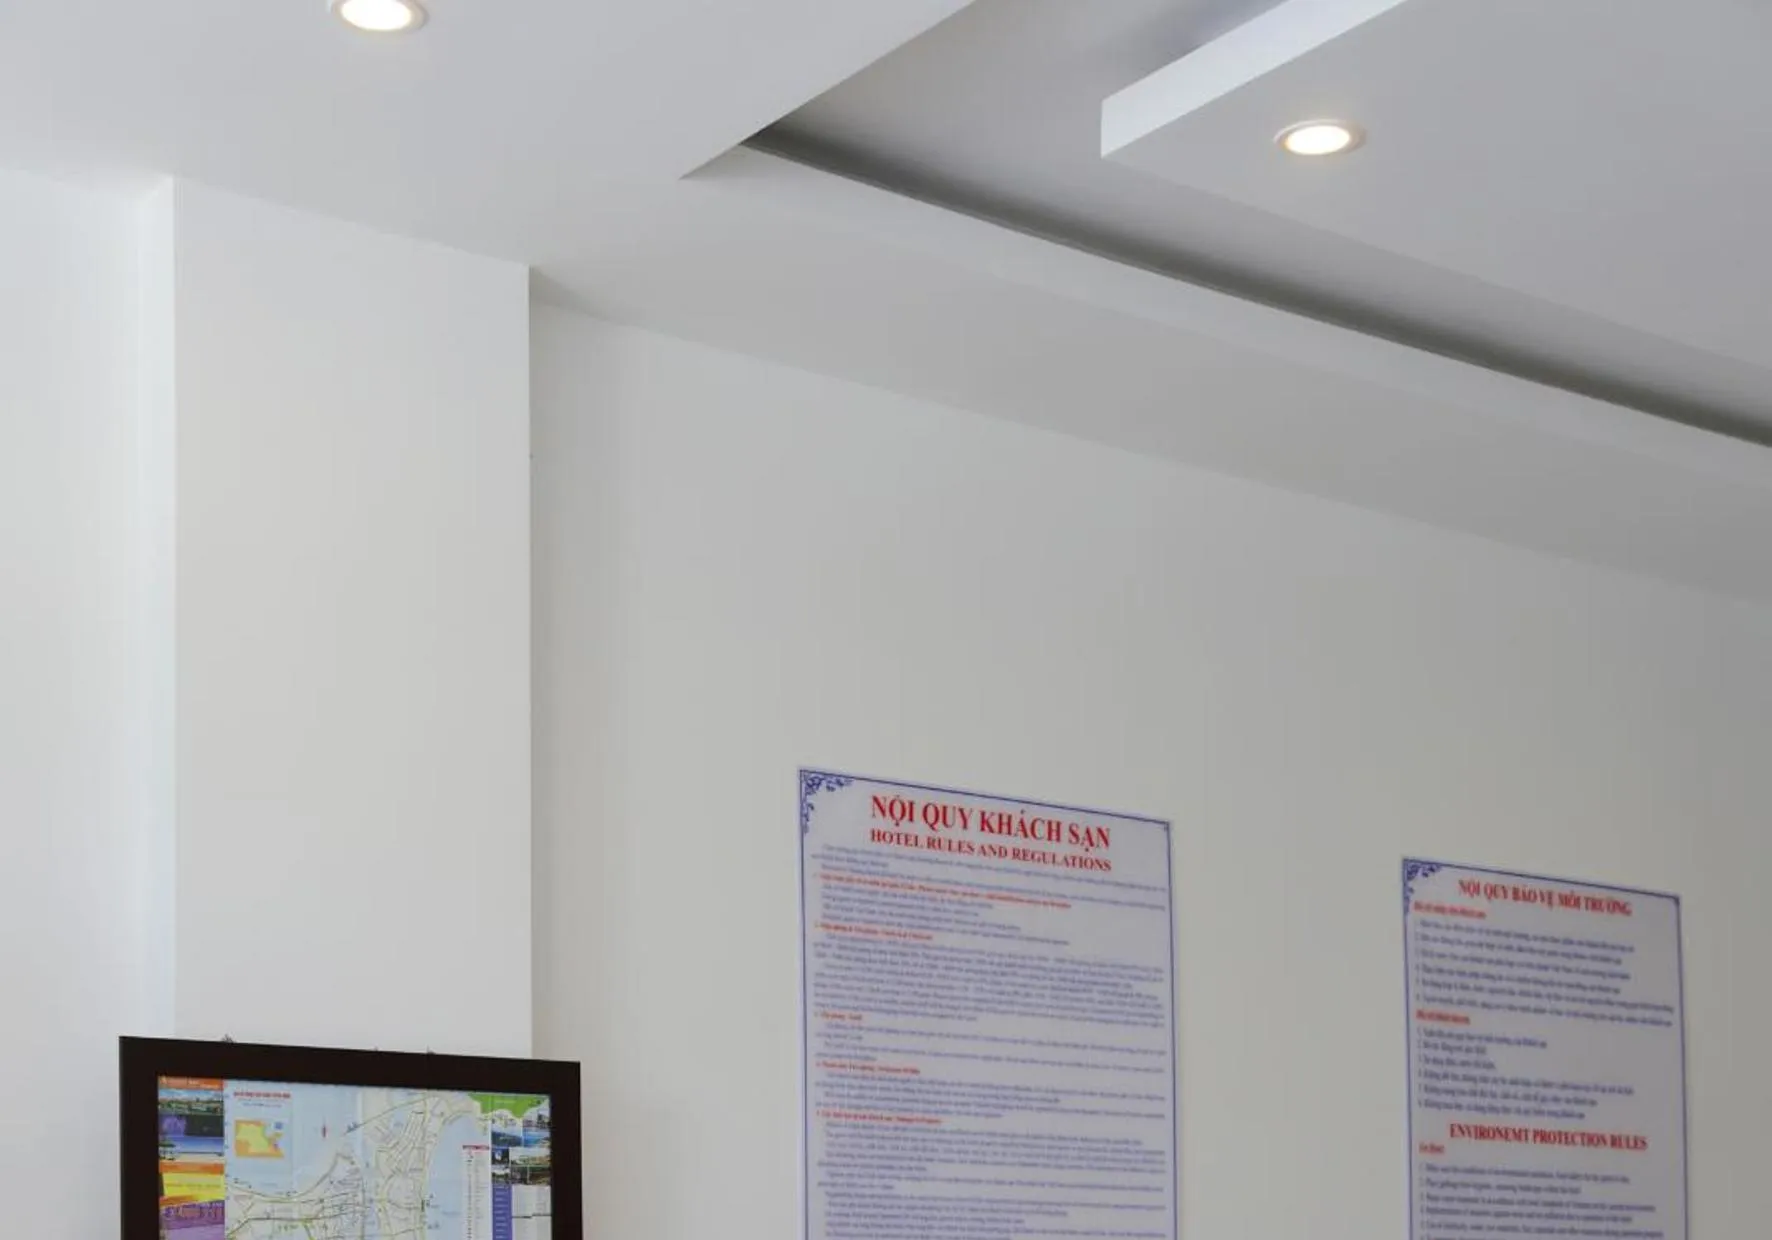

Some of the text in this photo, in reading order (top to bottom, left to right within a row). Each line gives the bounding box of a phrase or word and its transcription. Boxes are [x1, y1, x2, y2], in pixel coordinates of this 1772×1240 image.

[870, 795, 1111, 852] NỘI QUY KHÁCH SẠN
[869, 828, 1112, 872] HOTEL RULES AND REGULATIONS
[1533, 1128, 1607, 1148] PROTECTION
[1610, 1133, 1648, 1151] RULES
